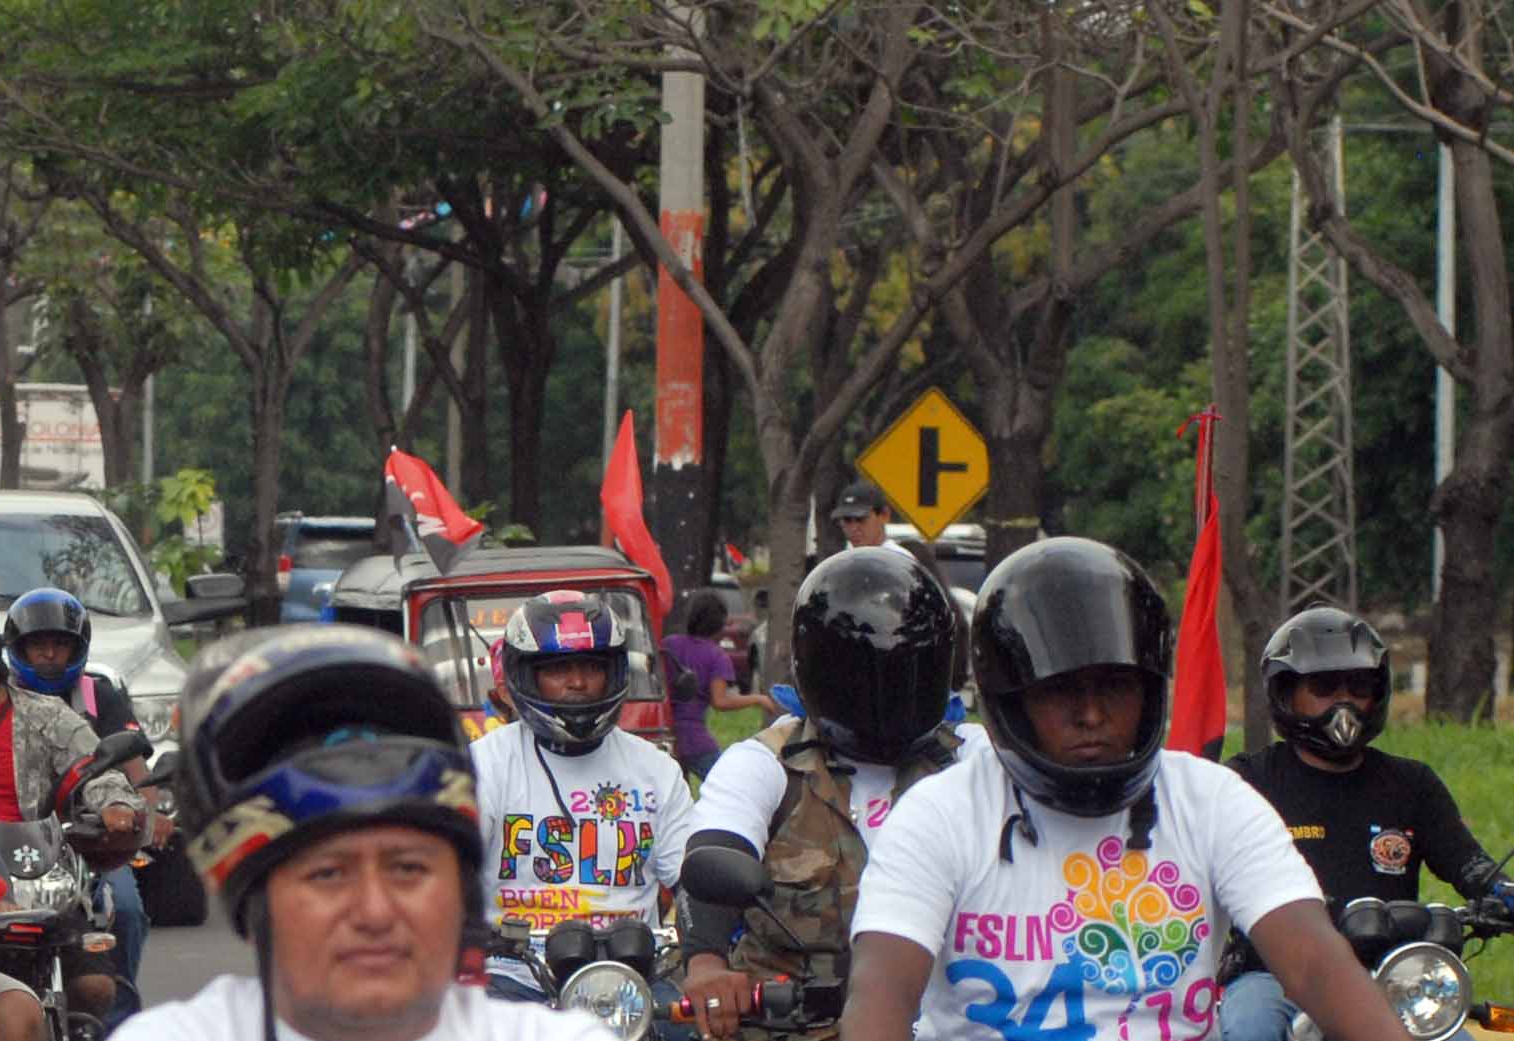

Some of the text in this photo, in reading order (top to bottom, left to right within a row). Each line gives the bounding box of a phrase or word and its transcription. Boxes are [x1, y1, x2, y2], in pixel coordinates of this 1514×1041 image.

[498, 814, 654, 887] FSLN
[501, 889, 580, 910] BUEN
[953, 911, 1053, 961] FSLN
